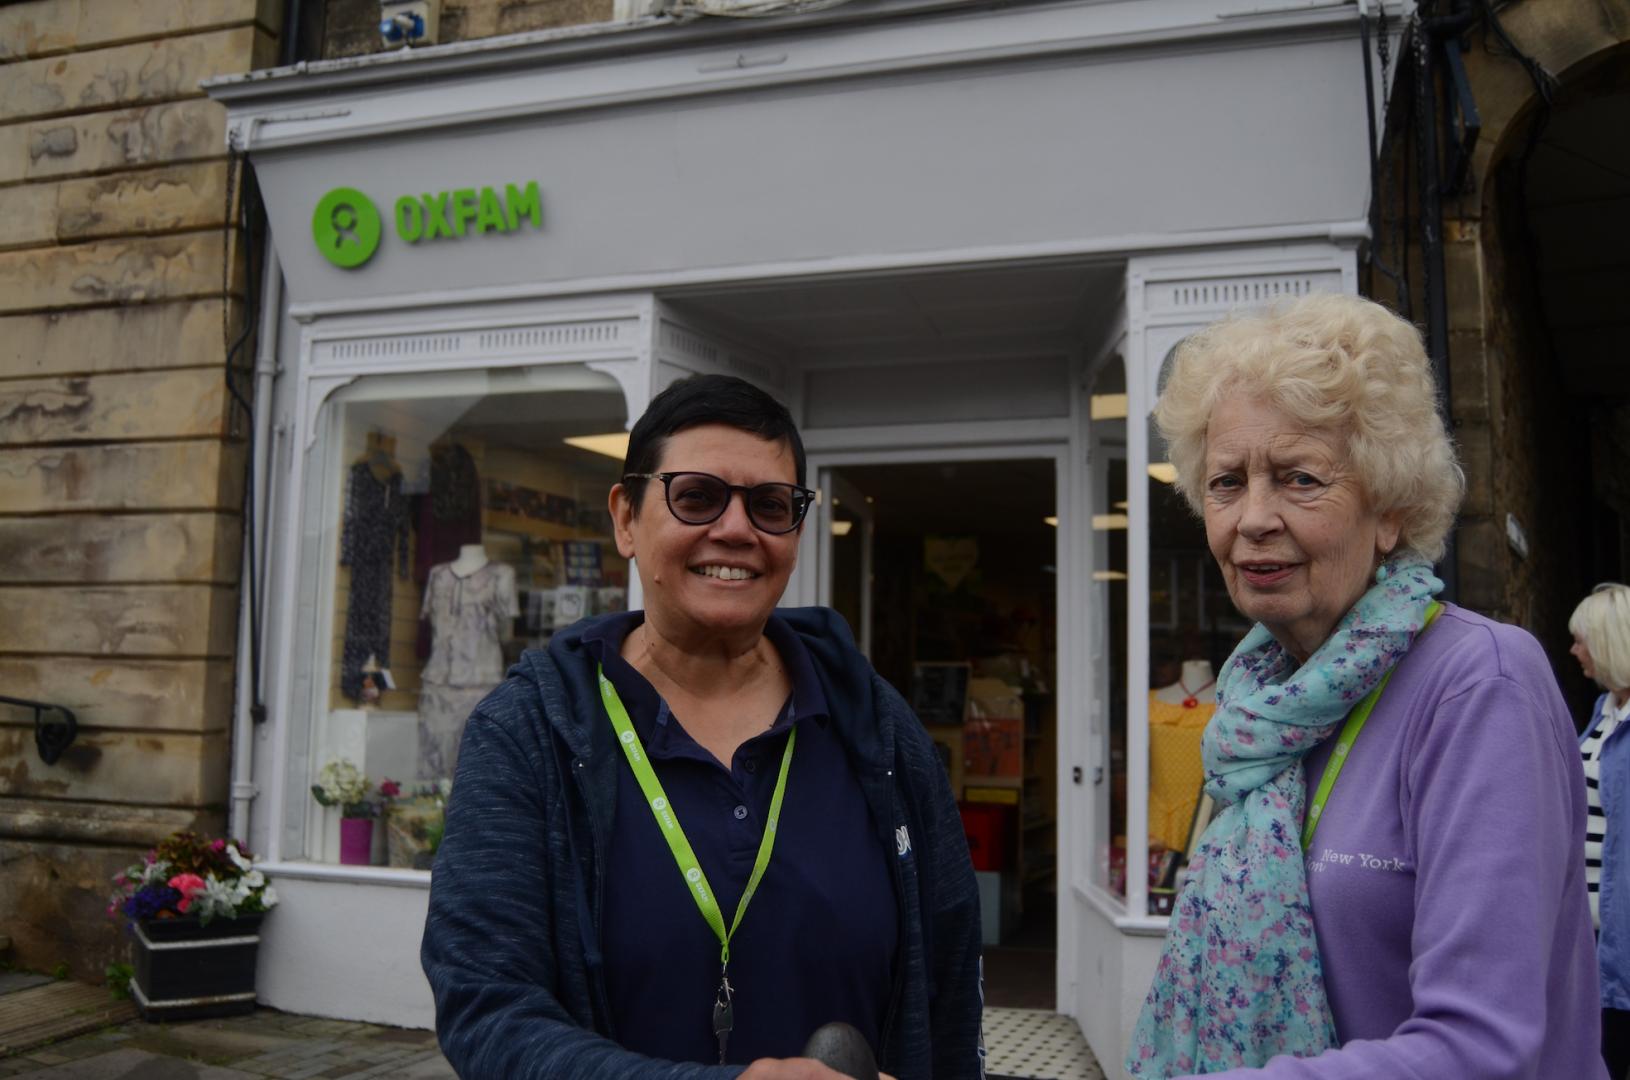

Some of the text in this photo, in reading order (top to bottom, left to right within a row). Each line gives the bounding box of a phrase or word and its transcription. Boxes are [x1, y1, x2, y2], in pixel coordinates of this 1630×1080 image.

[394, 180, 542, 243] OXFAM
[1320, 848, 1406, 871] New York
